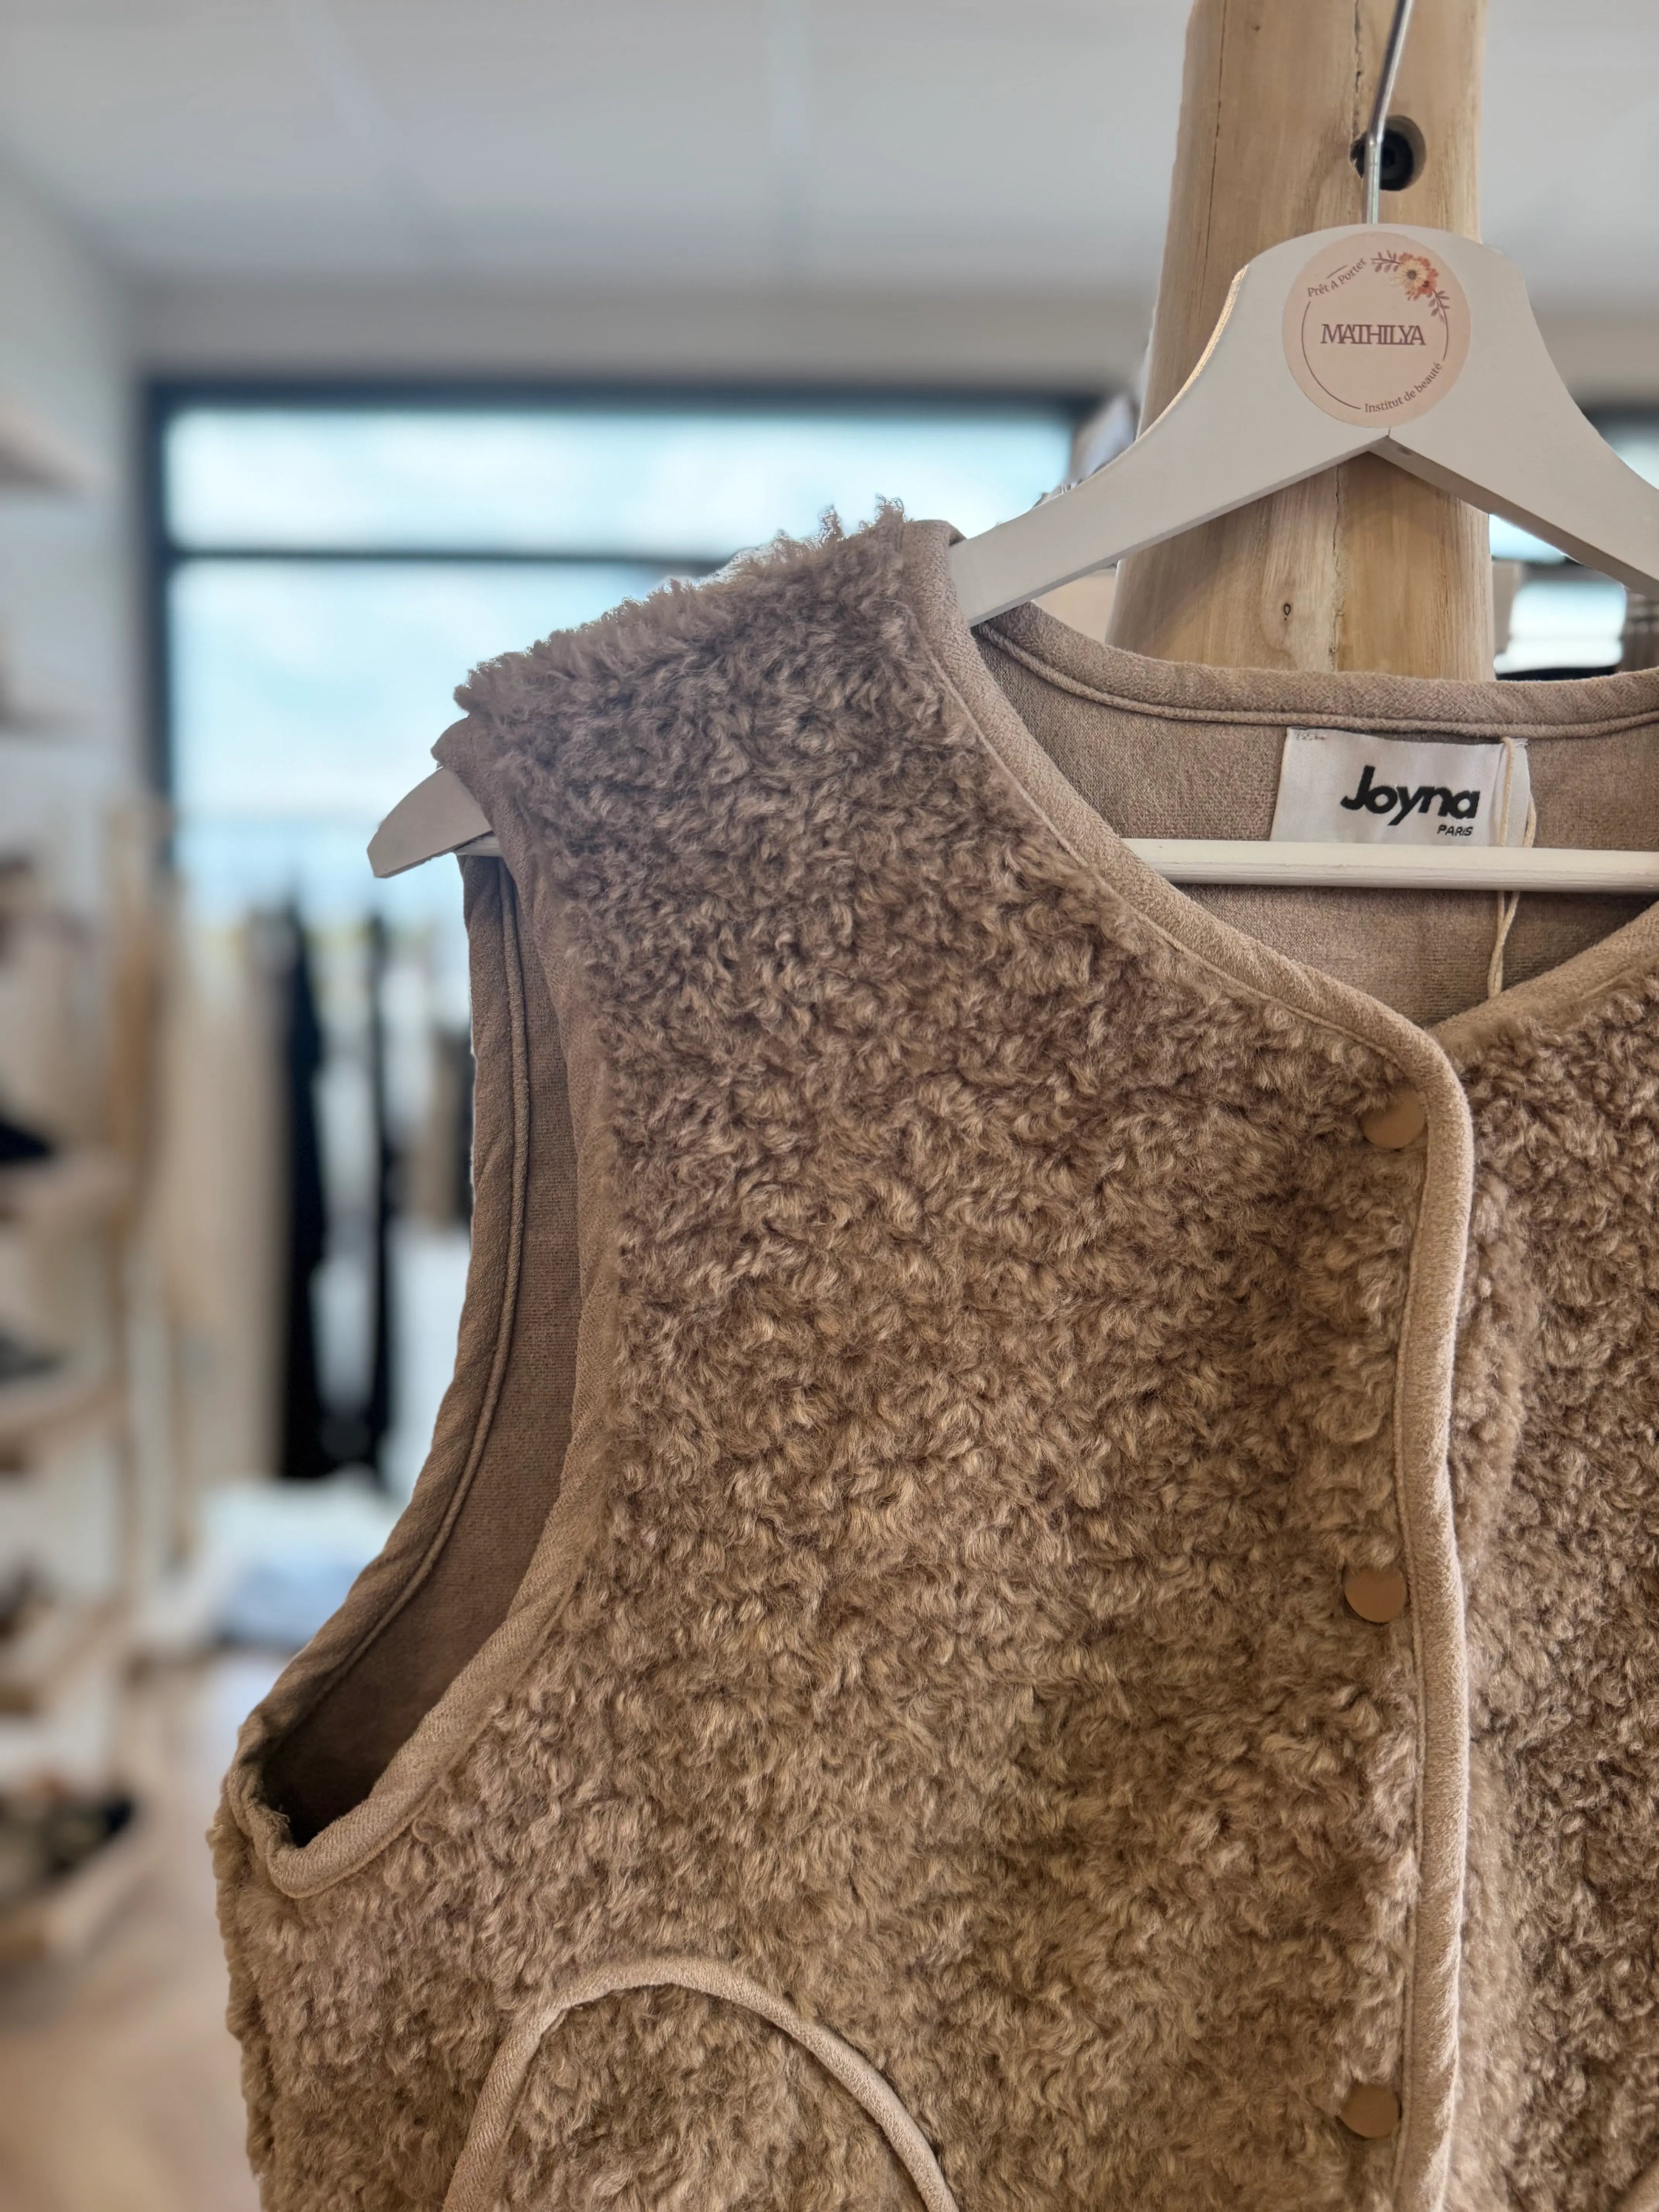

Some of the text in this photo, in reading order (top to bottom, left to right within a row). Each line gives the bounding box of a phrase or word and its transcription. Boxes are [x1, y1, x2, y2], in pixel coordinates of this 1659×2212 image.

[1307, 283, 1331, 297] Prêt
[1338, 257, 1367, 285] Porter
[1320, 323, 1427, 346] MATHILYA
[1364, 361, 1442, 413] Institut de beauté
[1340, 764, 1481, 826] Joyna
[1437, 824, 1474, 836] PARIS
